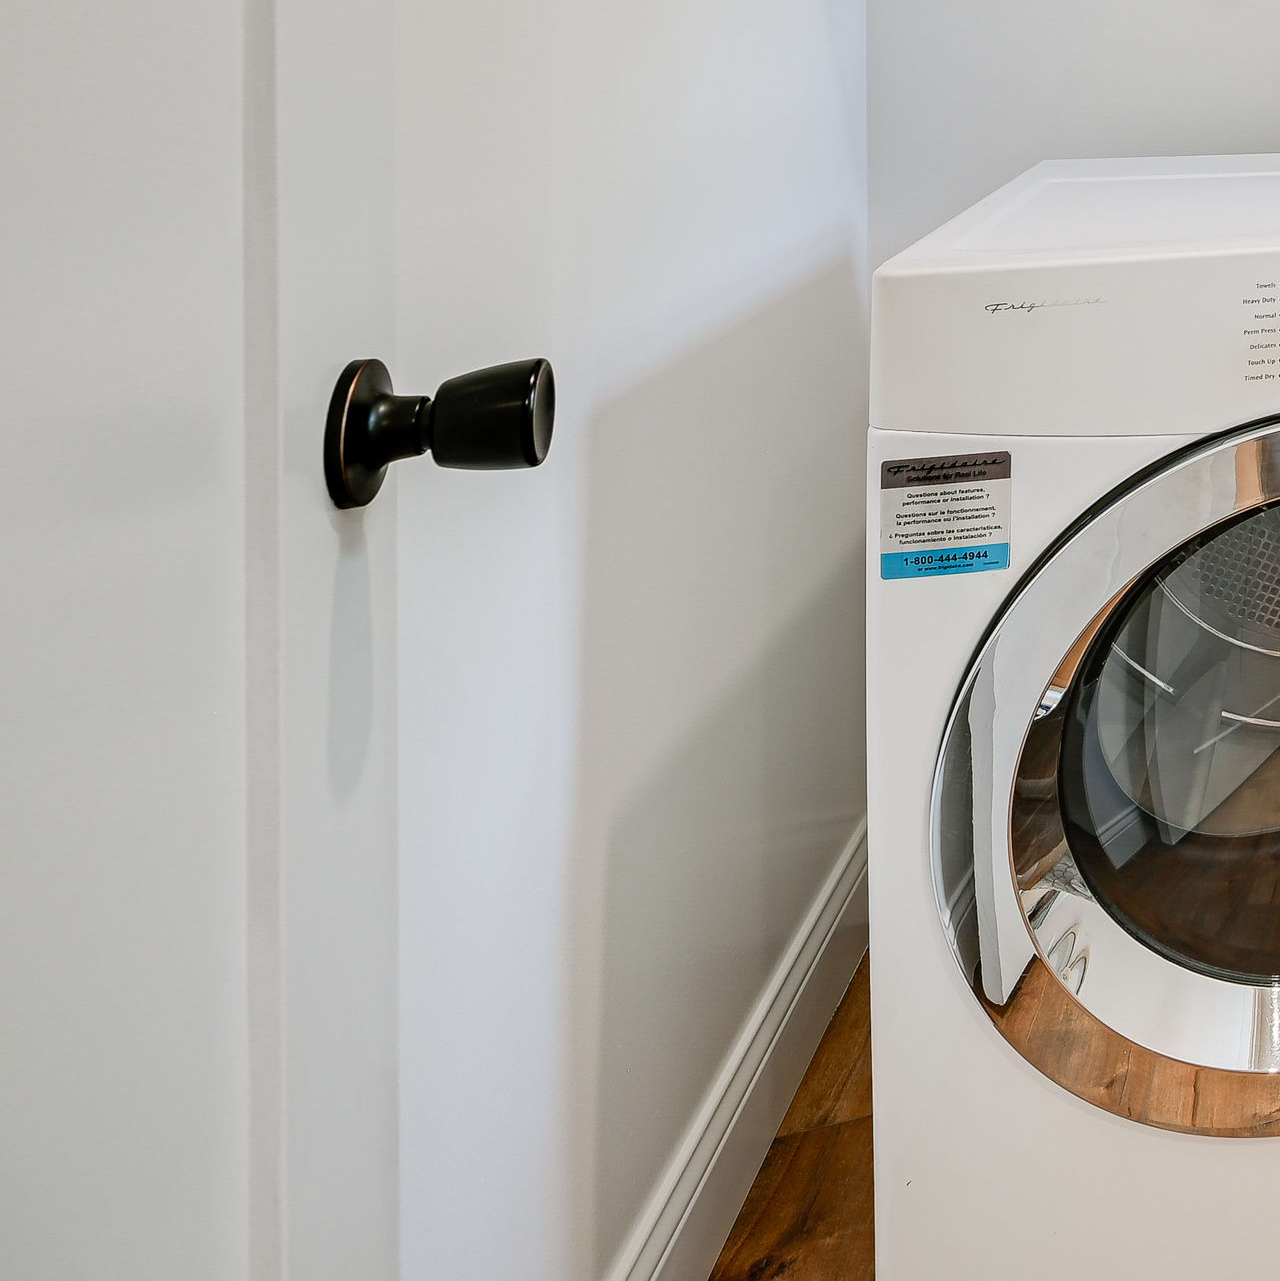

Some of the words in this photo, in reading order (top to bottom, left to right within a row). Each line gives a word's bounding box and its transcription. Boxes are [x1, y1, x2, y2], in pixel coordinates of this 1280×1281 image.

[887, 458, 1005, 476] Frigidaire
[907, 474, 941, 483] Solutions
[973, 469, 987, 477] Life
[907, 491, 938, 499] Questions
[902, 498, 940, 507] performance
[896, 511, 926, 519] Questions
[947, 506, 996, 514] fonctionnement,
[904, 517, 941, 526] performance
[952, 513, 990, 522] l'installation
[894, 531, 925, 539] Preguntas
[899, 537, 946, 545] funcionamiento
[904, 550, 988, 566] 1-800-444-4944
[925, 563, 974, 571] www.frigidaire.com
